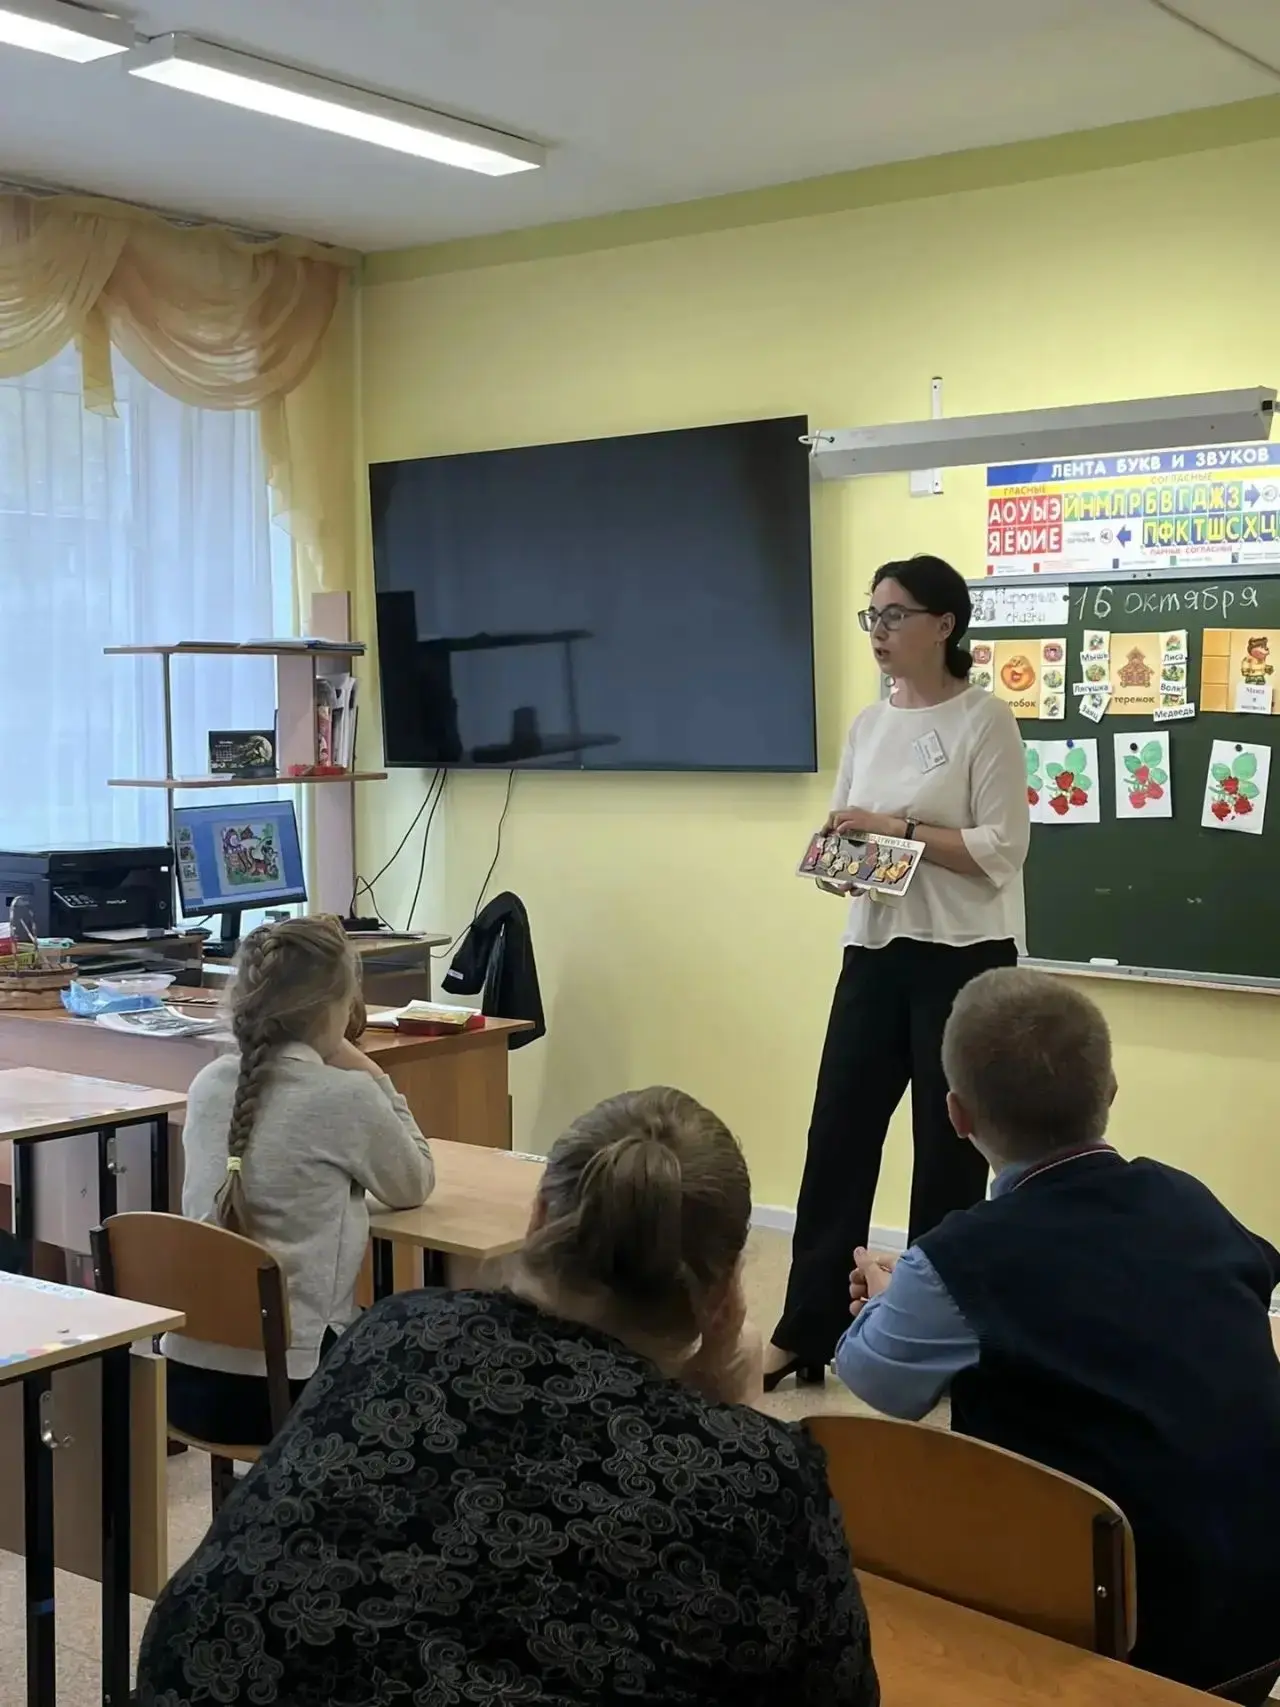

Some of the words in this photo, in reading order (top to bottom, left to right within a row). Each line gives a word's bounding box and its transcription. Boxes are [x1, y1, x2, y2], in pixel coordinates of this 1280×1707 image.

[1051, 460, 1106, 478] ЛЕНТА
[1116, 455, 1161, 473] БУКВ
[1172, 454, 1185, 469] И
[1195, 447, 1269, 466] ЗВУКОВ
[1004, 485, 1046, 496] ГЛАСНЫЕ
[1074, 585, 1113, 620] 16
[1124, 586, 1258, 619] октября
[1081, 653, 1108, 662] Мышь
[1163, 654, 1184, 662] Лиса
[1074, 685, 1109, 693] Лягушка
[1160, 683, 1182, 692] Волк
[1114, 696, 1156, 705] теремок
[1154, 707, 1194, 719] Медведь
